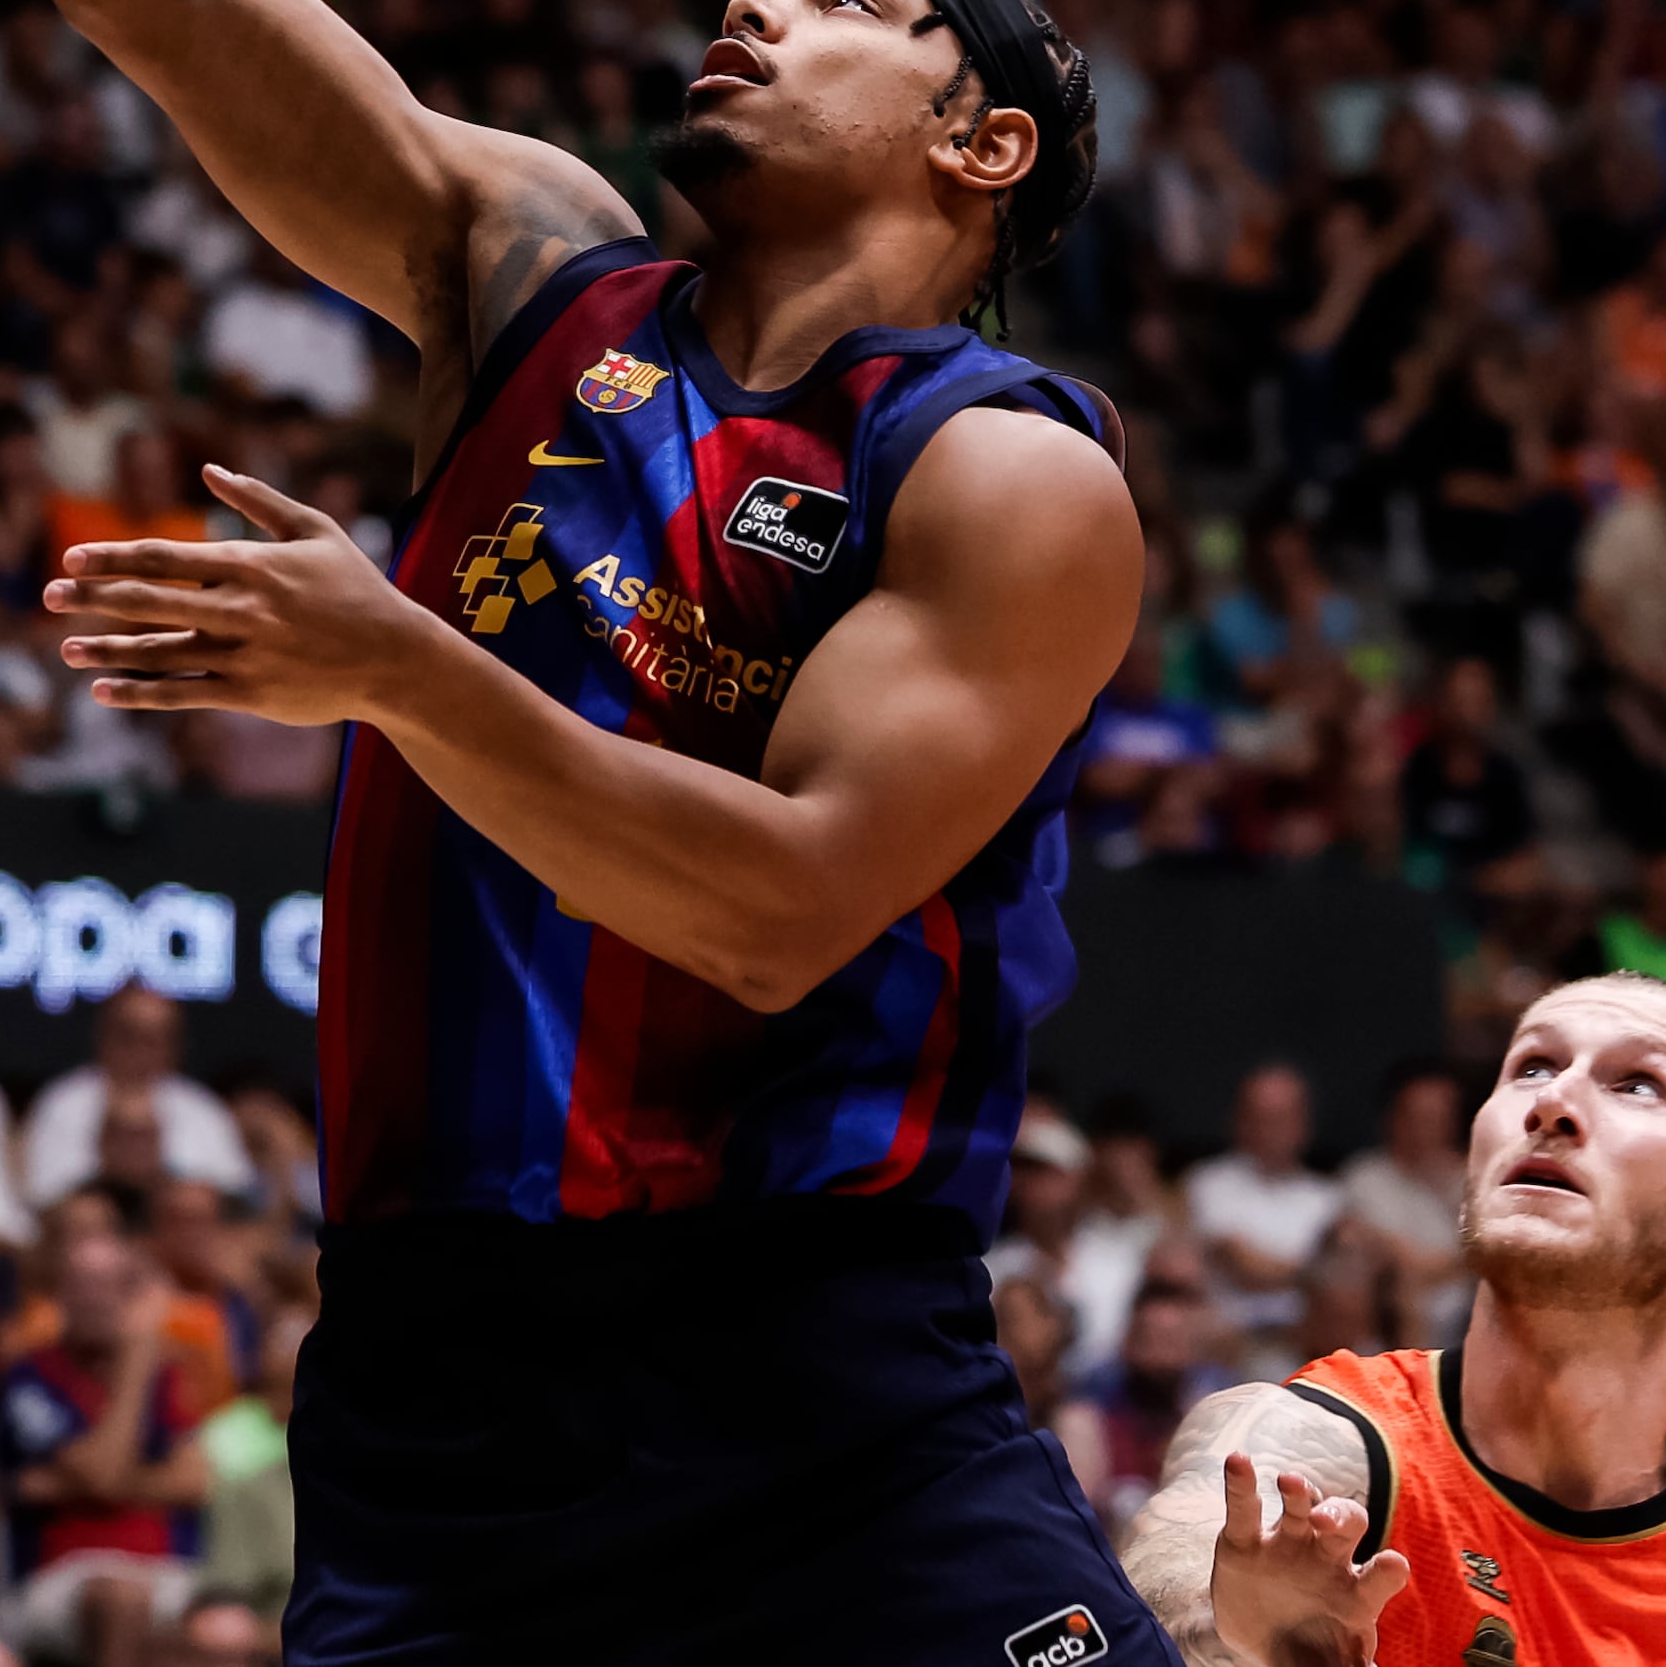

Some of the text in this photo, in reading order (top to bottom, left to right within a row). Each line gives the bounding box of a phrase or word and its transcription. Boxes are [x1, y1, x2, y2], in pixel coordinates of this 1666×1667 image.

[746, 495, 789, 522] liga
[736, 518, 826, 562] endesa
[1027, 1635, 1086, 1667] acb
